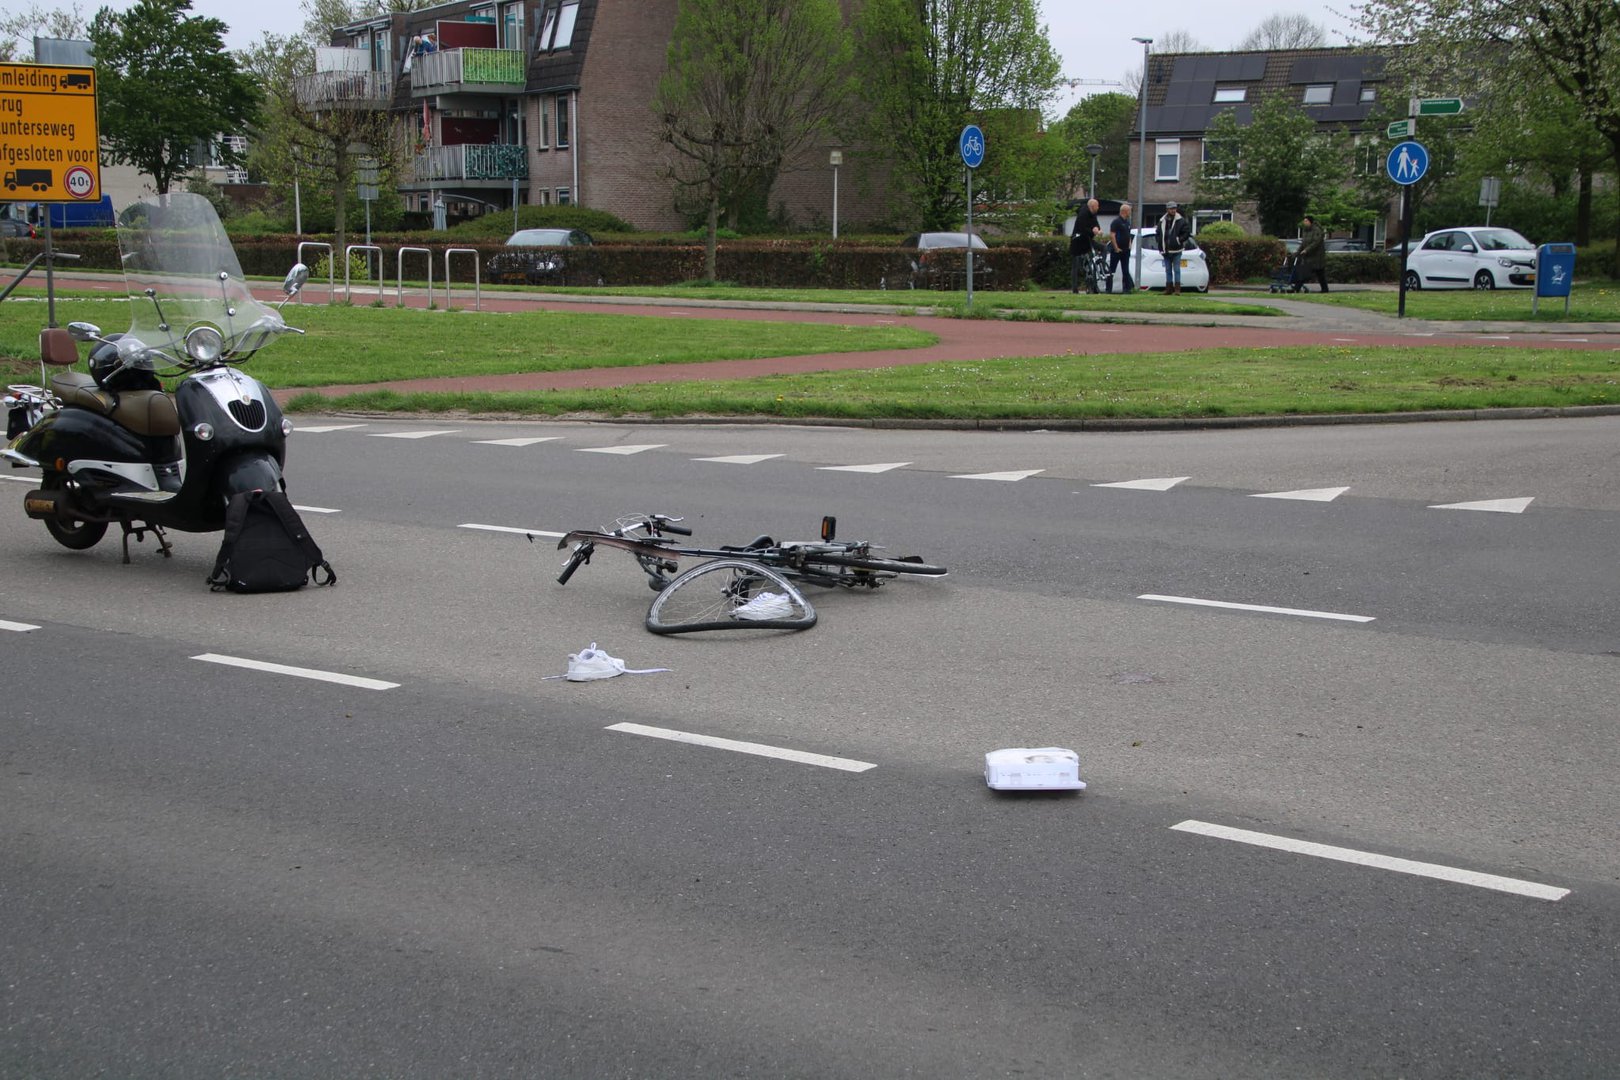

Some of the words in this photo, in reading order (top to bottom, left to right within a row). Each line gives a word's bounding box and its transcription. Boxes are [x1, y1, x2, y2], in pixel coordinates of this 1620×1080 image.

[0, 68, 58, 92] mleiding
[0, 98, 23, 117] rug
[0, 119, 75, 141] unterseweg
[67, 149, 95, 163] voor
